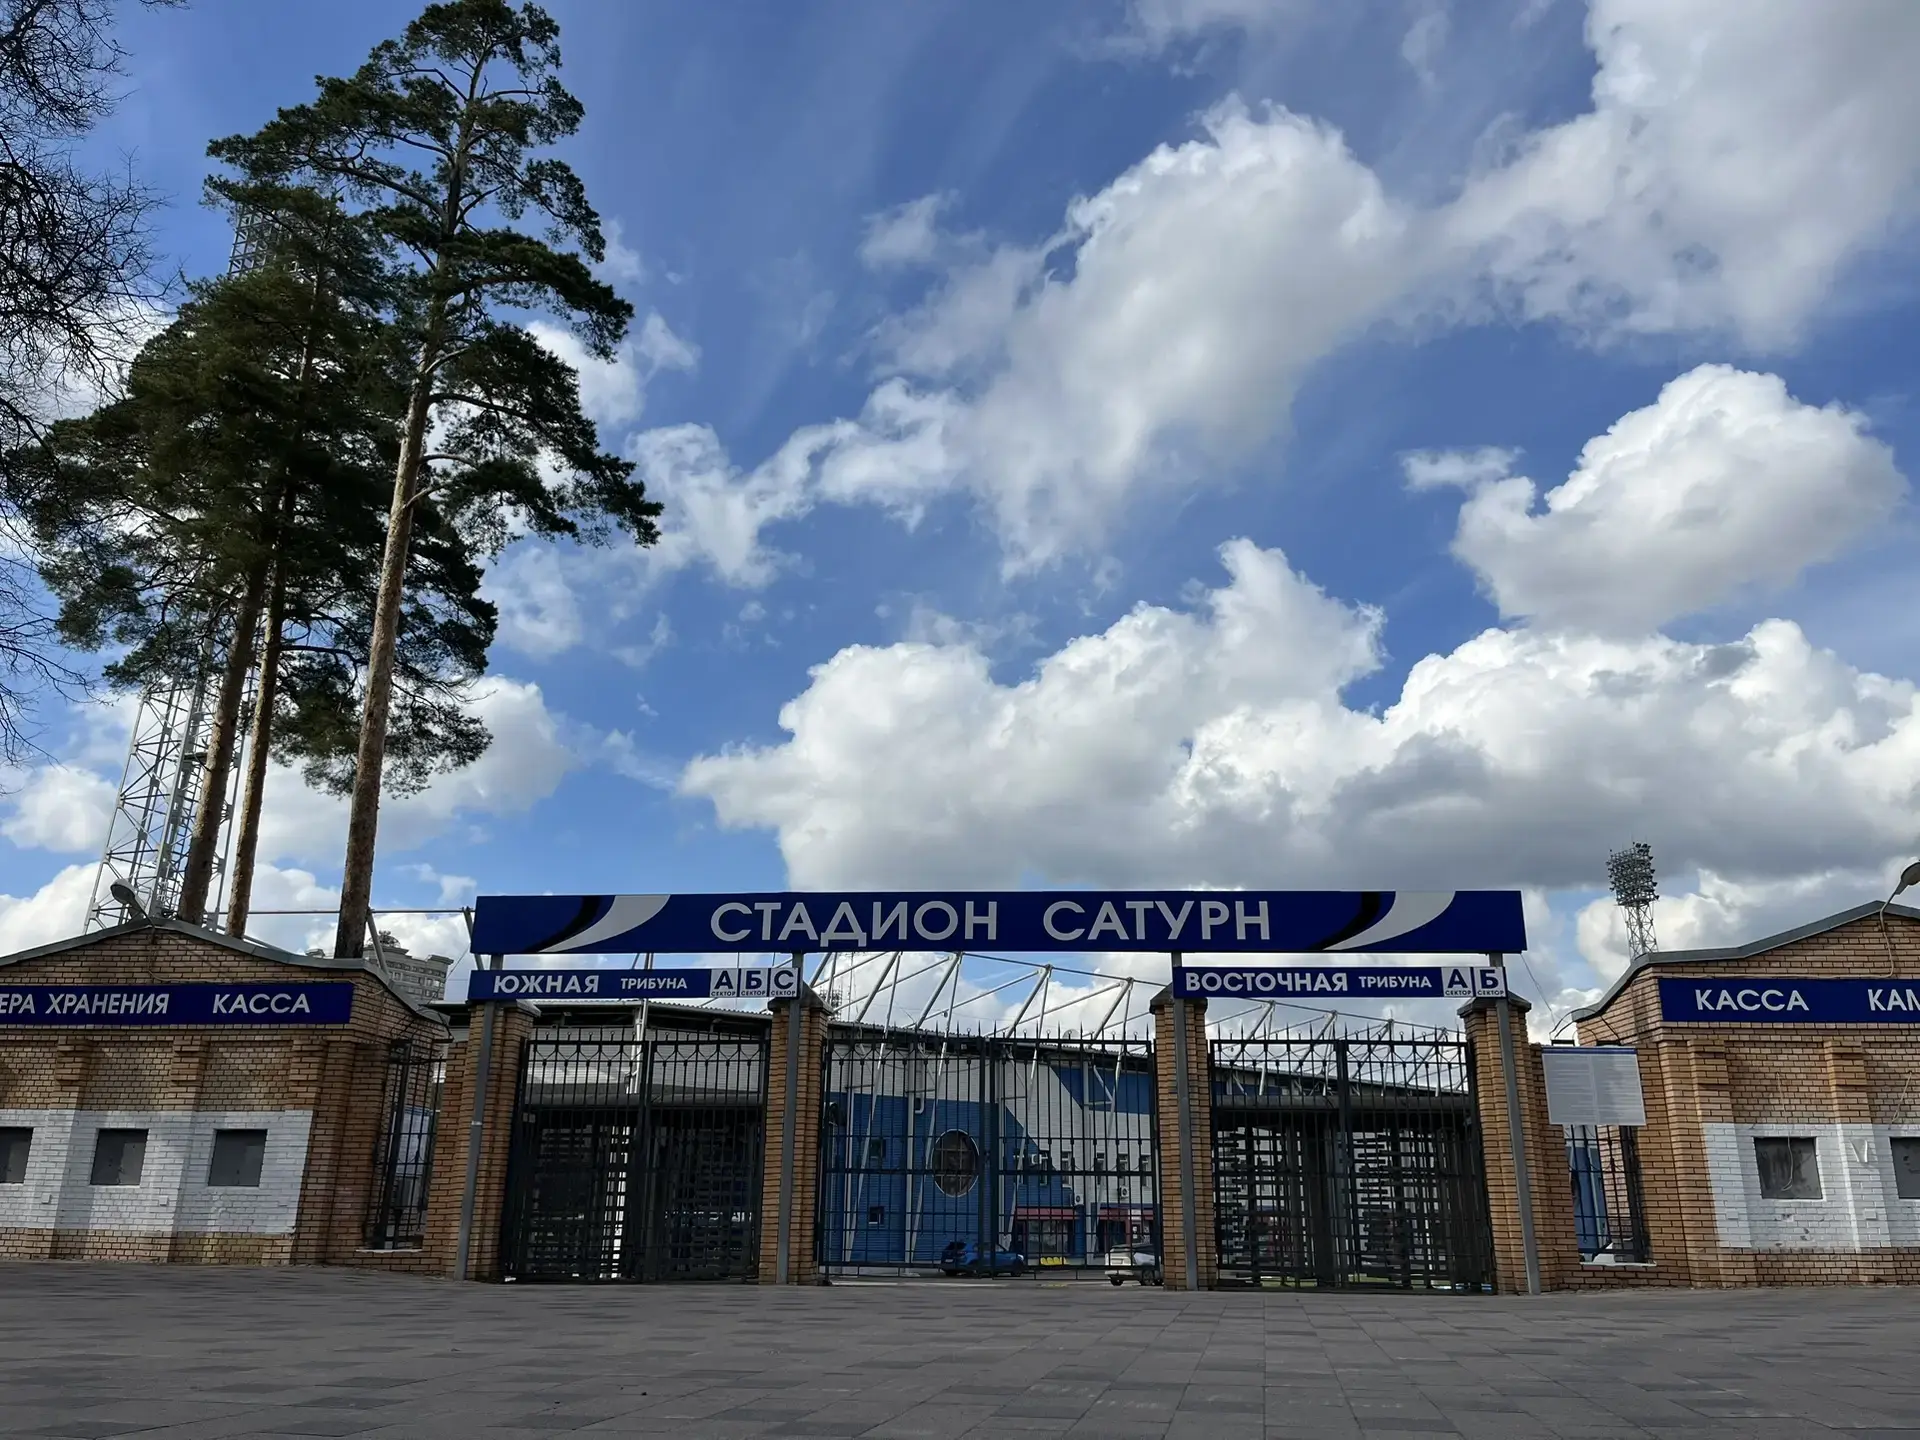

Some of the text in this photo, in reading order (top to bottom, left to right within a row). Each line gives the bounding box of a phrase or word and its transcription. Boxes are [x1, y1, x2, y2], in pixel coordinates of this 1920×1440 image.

[710, 900, 1271, 947] СТАДИОН САТУРН
[493, 975, 600, 994] ЮЖНАЯ
[620, 977, 688, 990] ТРИБУНА
[713, 970, 734, 990] А
[745, 970, 763, 990] Б
[1185, 968, 1499, 992] ВОСТОЧНАЯ ТРИБУНА А Б
[45, 993, 170, 1014] ХРАНЕНИЯ
[212, 993, 311, 1014] КАССА
[1695, 989, 1810, 1011] КАССА
